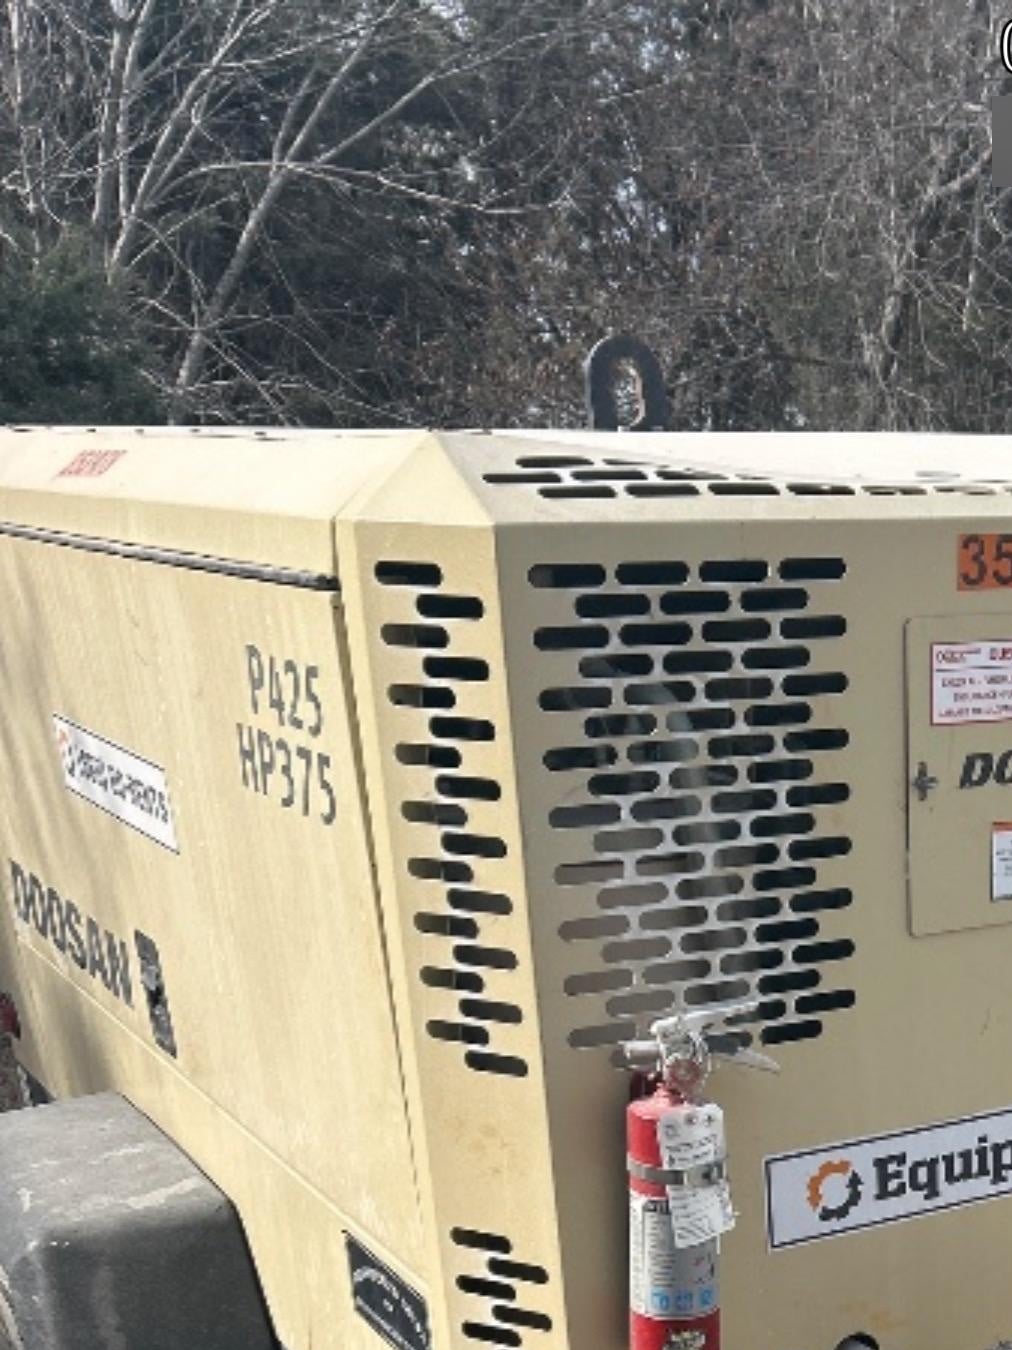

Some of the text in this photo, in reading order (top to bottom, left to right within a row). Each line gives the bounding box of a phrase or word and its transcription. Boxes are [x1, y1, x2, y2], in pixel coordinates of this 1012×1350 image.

[245, 644, 323, 738] P425
[236, 722, 337, 826] HP375
[9, 857, 135, 1010] DOOSAN
